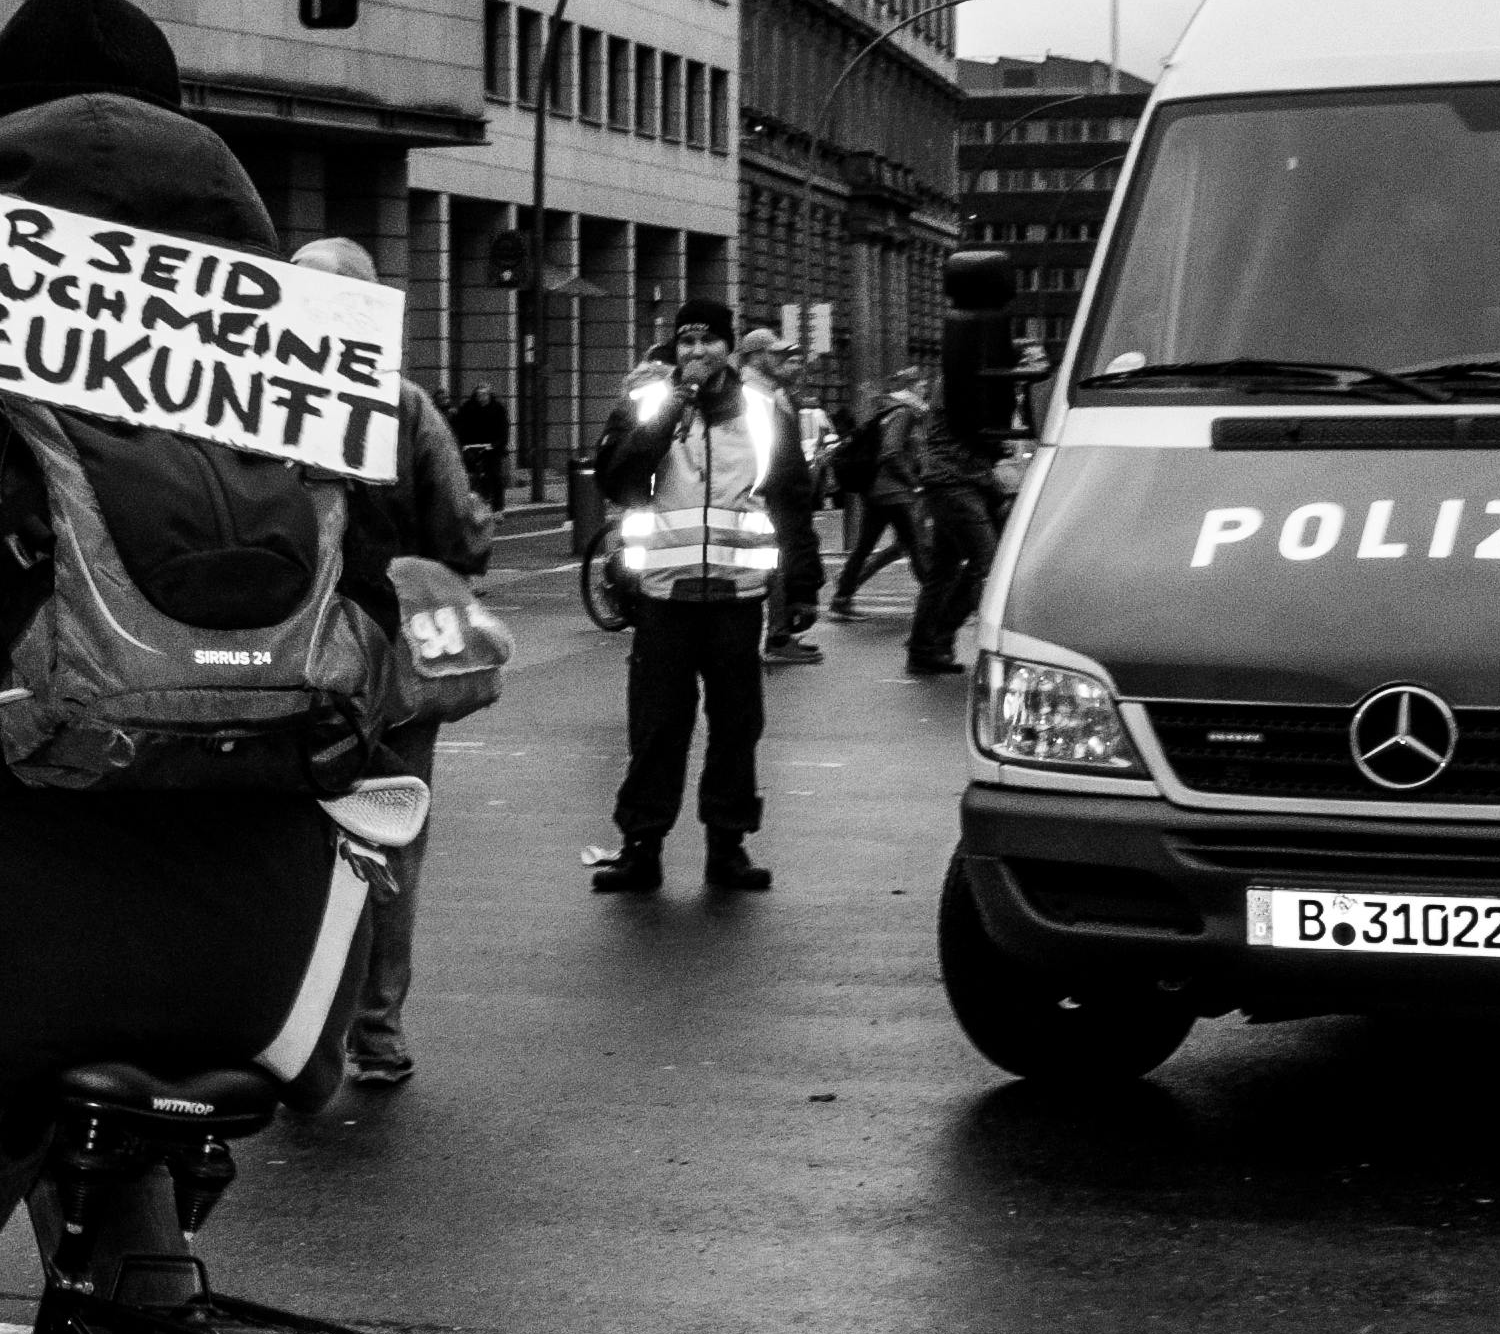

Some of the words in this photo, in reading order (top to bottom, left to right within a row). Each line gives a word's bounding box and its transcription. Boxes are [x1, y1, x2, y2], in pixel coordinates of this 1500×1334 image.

[87, 230, 282, 311] SEID
[141, 294, 383, 388] MEINE
[194, 649, 251, 666] SIRRUS
[252, 650, 272, 666] 24
[1298, 899, 1327, 942] B
[152, 1098, 216, 1116] WITTKOP
